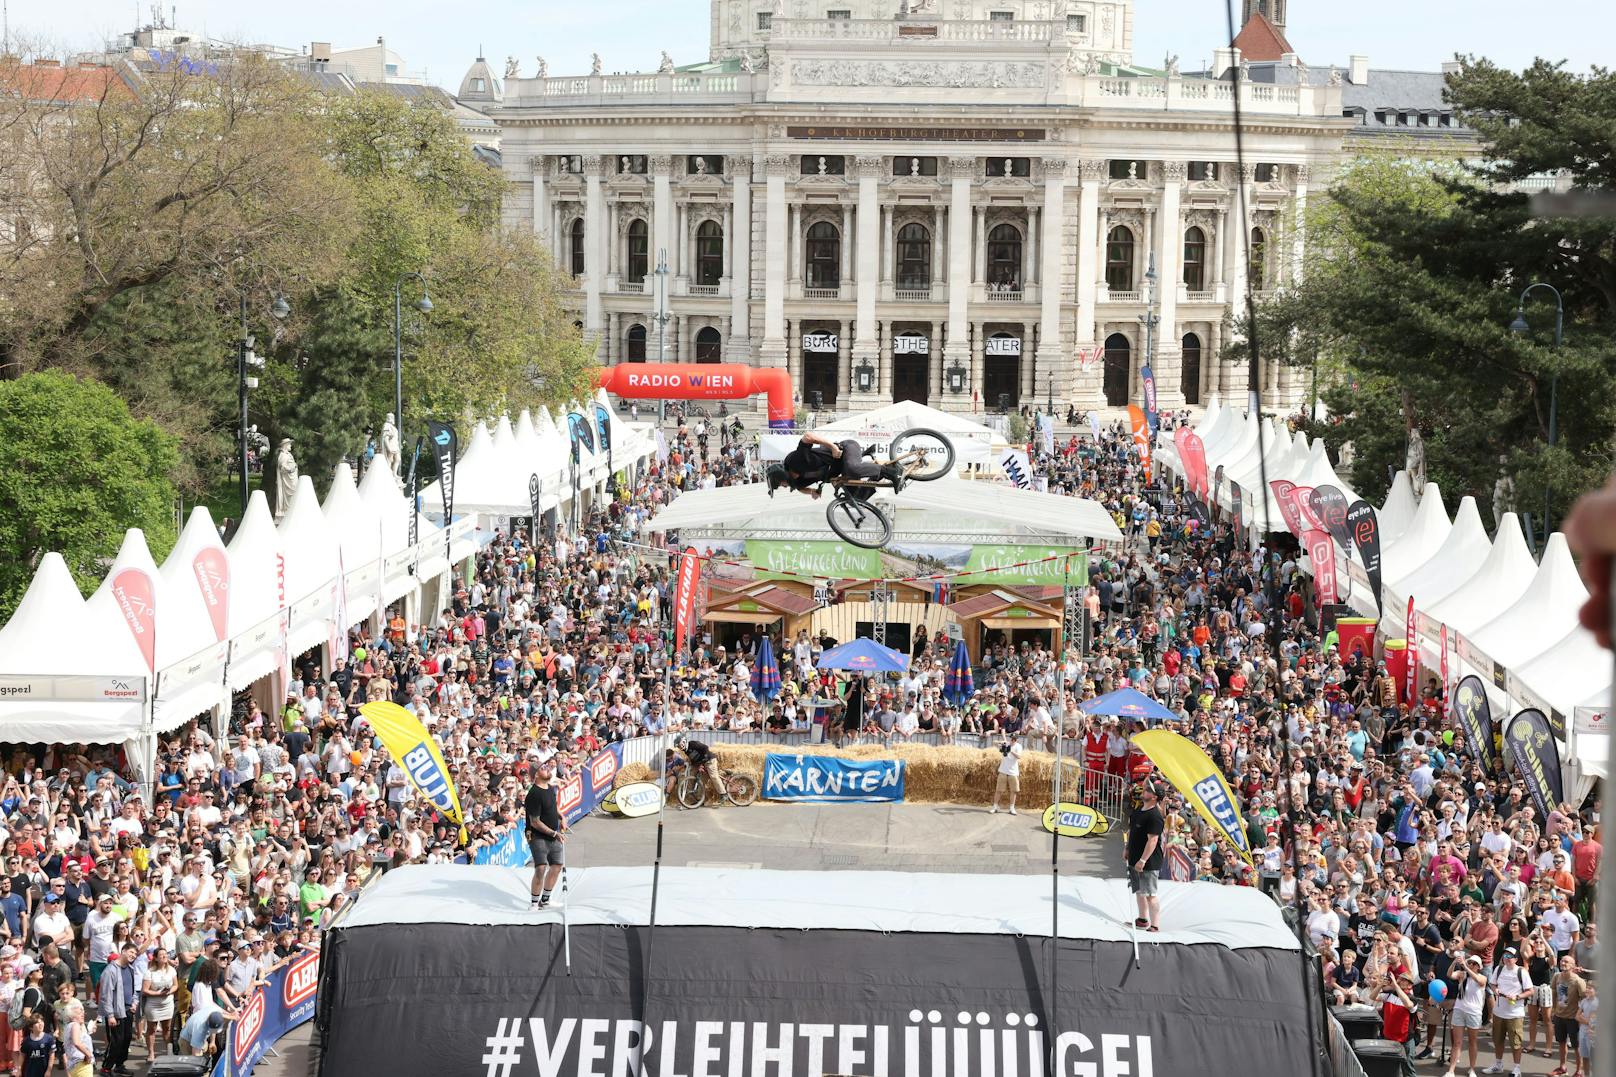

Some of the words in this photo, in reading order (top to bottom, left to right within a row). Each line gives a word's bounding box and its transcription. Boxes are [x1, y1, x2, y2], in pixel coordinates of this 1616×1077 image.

[858, 128, 1000, 139] HOFBURGTHEATER
[628, 374, 681, 387] RADIO
[688, 374, 734, 387] WIEN
[678, 556, 694, 626] FLACHAU
[0, 684, 31, 696] gspezl
[766, 754, 900, 795] KÄRNTEN
[631, 788, 659, 807] CLUB
[1060, 812, 1092, 828] CLUB
[290, 958, 319, 998] ABU
[238, 1000, 261, 1053] ABUS
